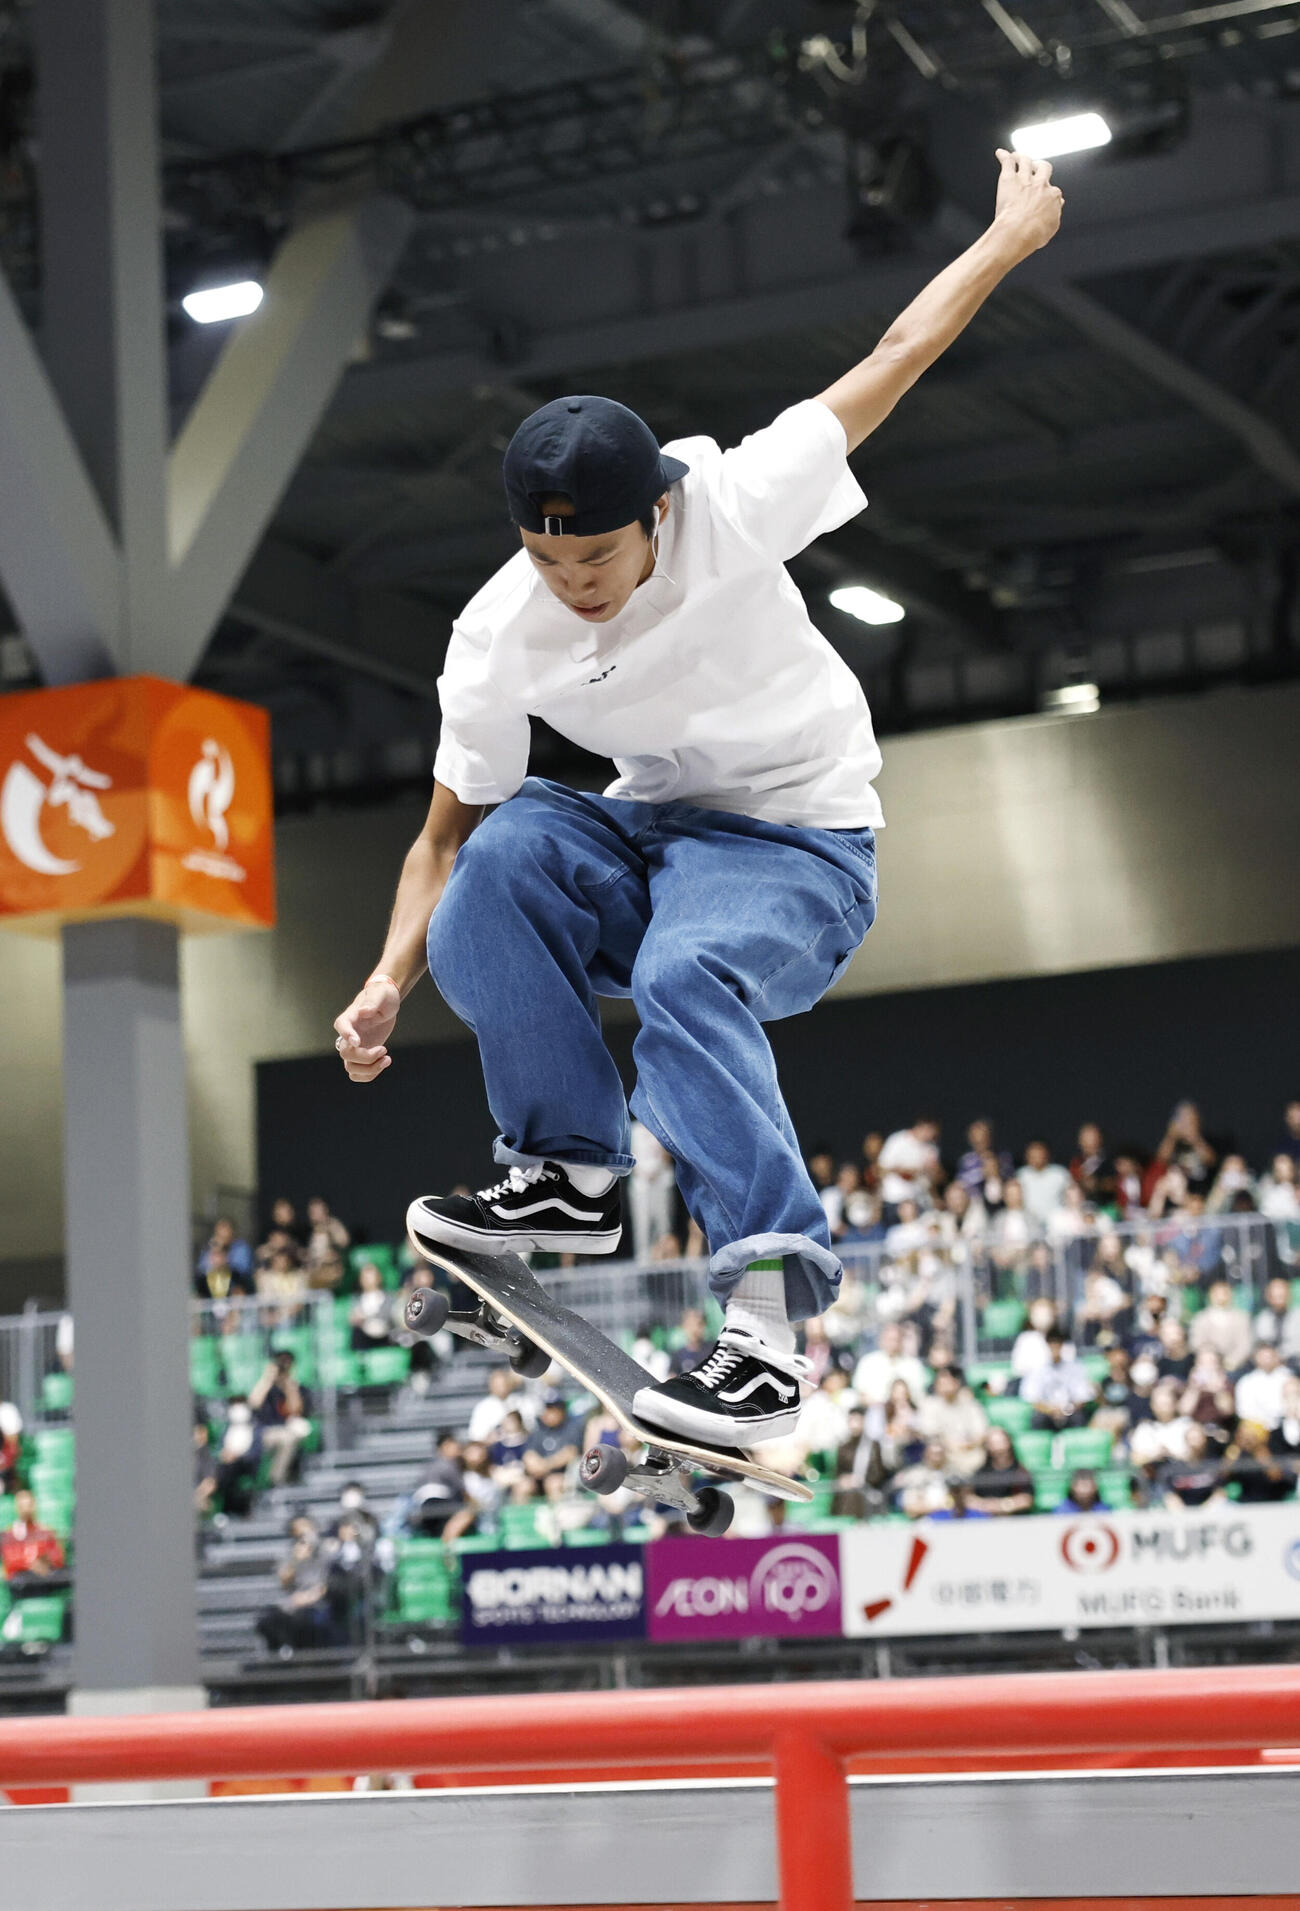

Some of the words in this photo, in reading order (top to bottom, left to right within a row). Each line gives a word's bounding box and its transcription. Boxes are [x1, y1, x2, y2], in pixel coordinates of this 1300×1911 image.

[1131, 1523, 1252, 1562] MUFG
[468, 1563, 642, 1607] BORNAN
[1174, 1586, 1240, 1610] Bank
